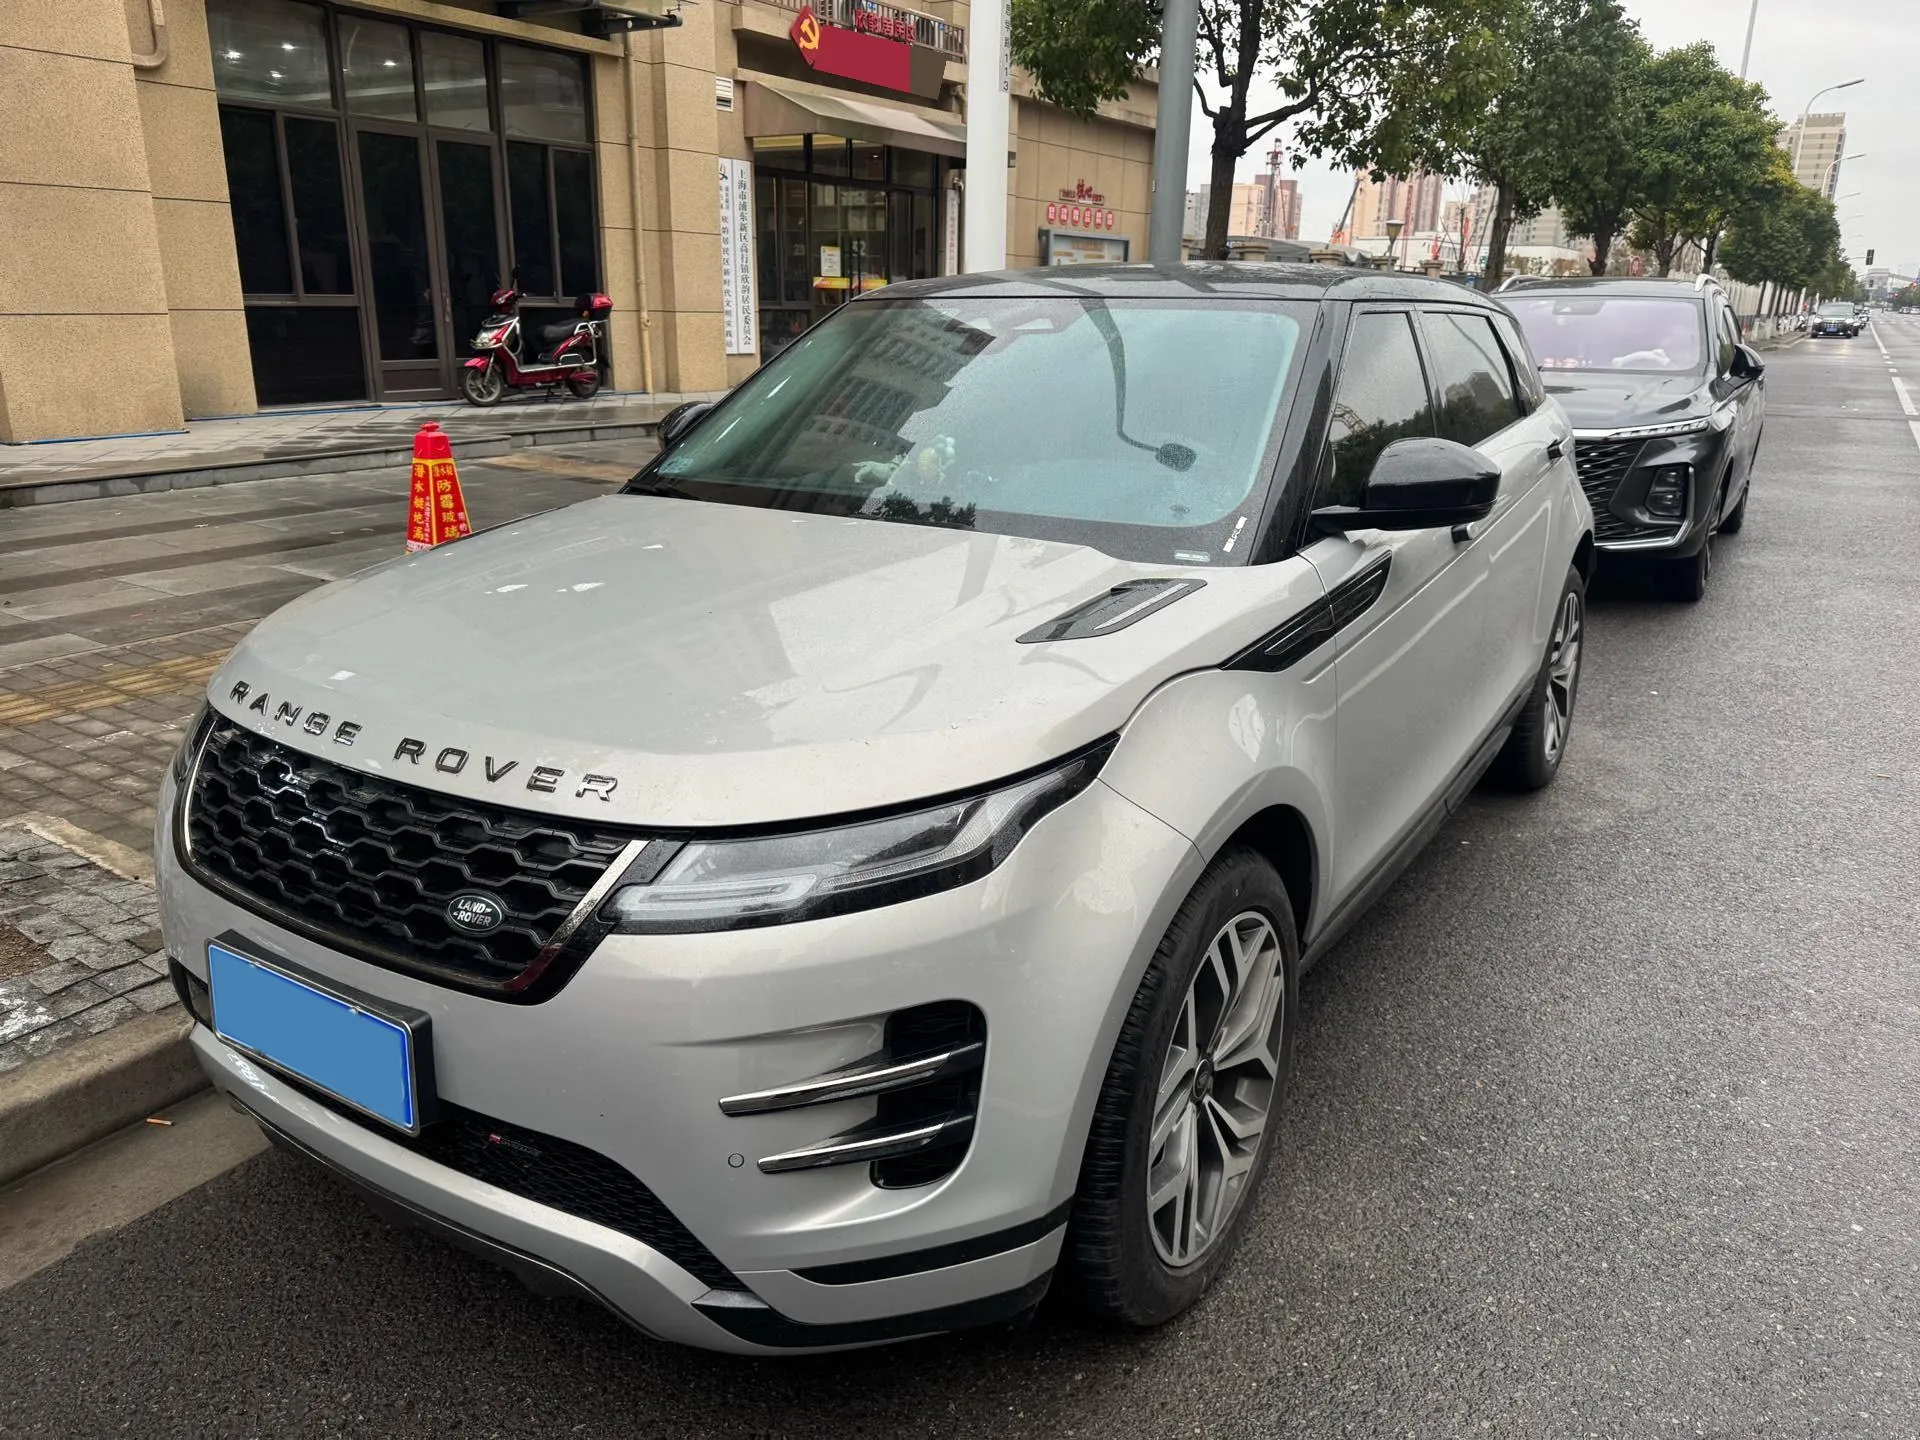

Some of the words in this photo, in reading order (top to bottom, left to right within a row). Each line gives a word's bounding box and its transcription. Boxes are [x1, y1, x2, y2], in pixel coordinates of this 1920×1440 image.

[413, 464, 425, 540] 潜水艇地漏
[229, 680, 363, 746] RANGE
[394, 736, 619, 801] ROVER
[456, 910, 492, 927] ROVER
[457, 899, 487, 914] LAND
